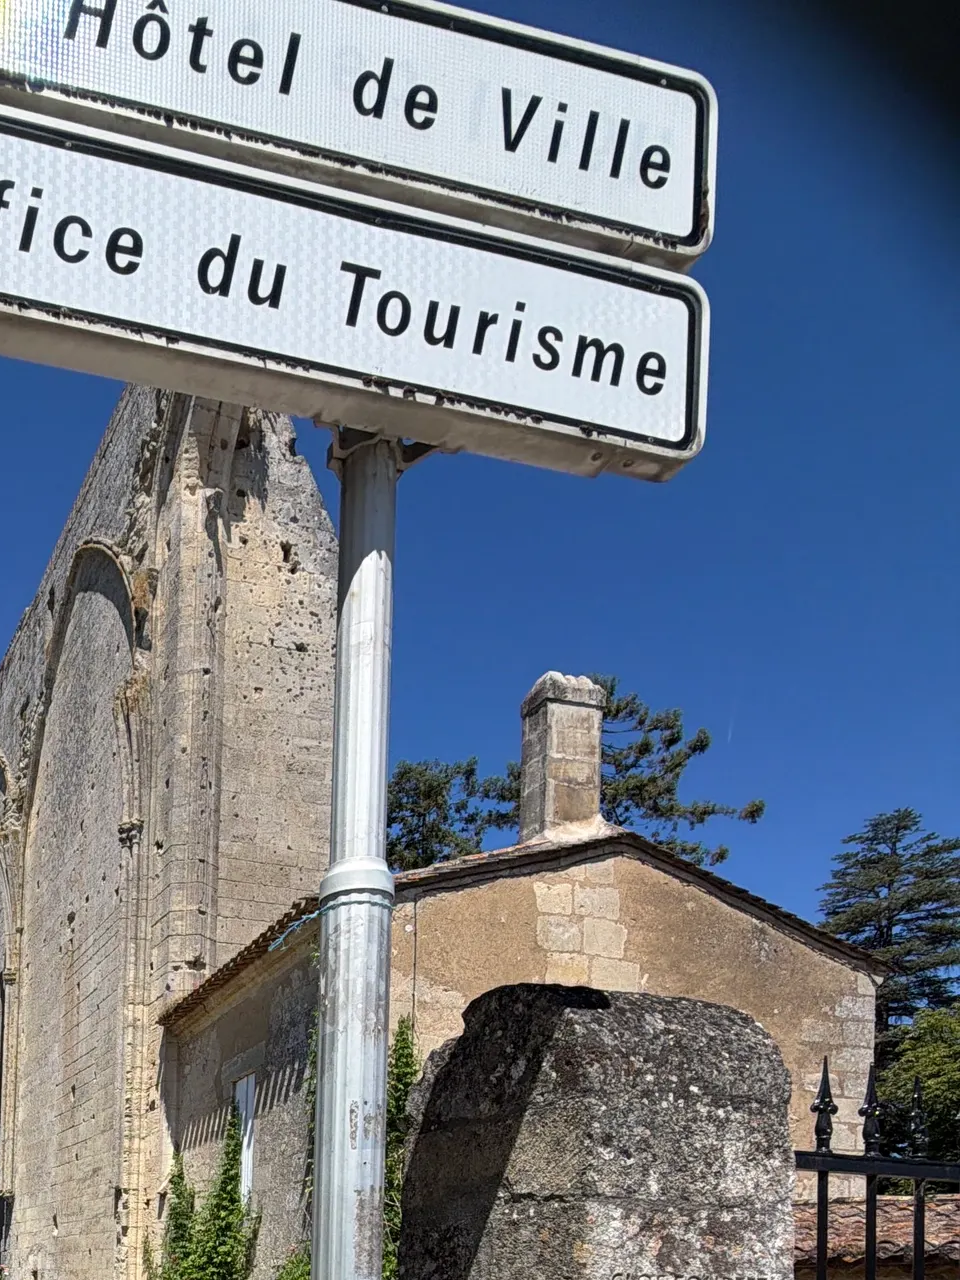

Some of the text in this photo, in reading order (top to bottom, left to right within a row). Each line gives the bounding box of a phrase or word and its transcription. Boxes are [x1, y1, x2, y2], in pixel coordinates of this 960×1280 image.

[63, 0, 671, 190] Hôtel de Ville
[197, 233, 287, 310] du
[340, 261, 667, 396] Tourisme
